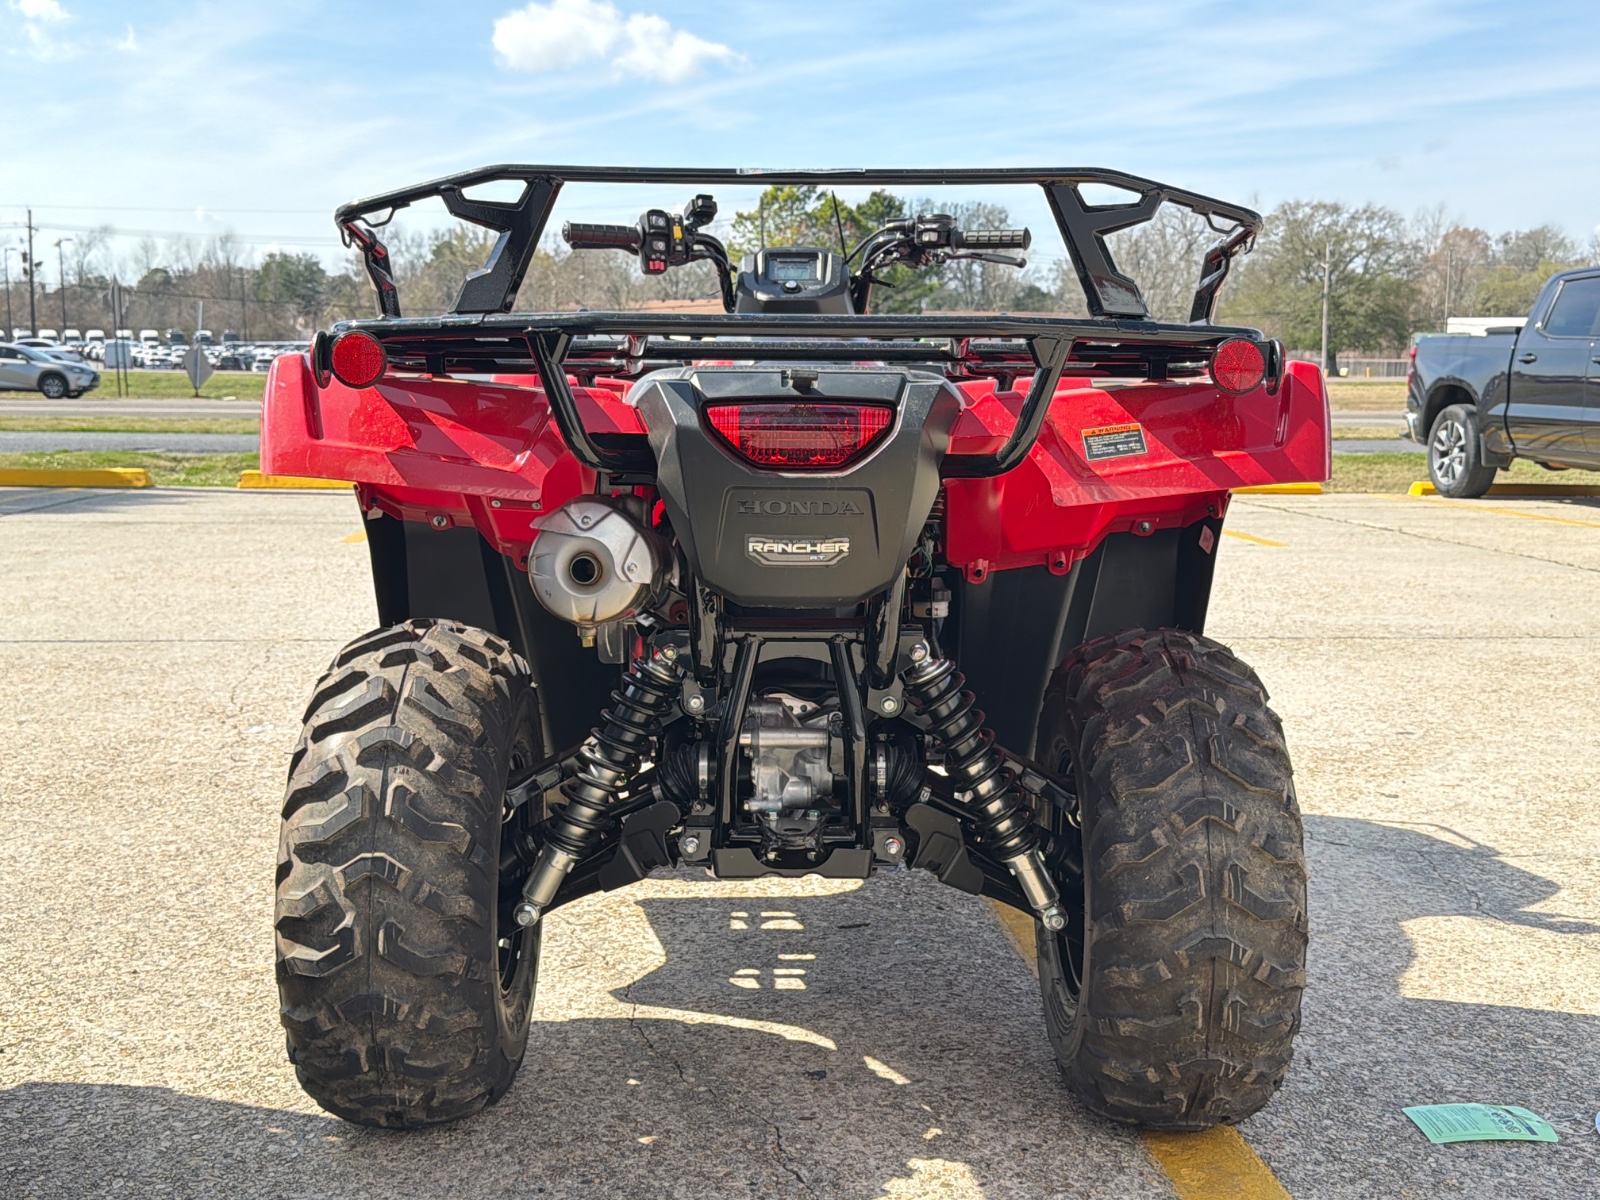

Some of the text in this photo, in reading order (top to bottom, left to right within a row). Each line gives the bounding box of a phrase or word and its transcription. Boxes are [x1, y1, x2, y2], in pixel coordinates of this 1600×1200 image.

[1098, 425, 1131, 433] WARNING
[737, 500, 864, 515] HONDA
[748, 542, 850, 553] RANCHER
